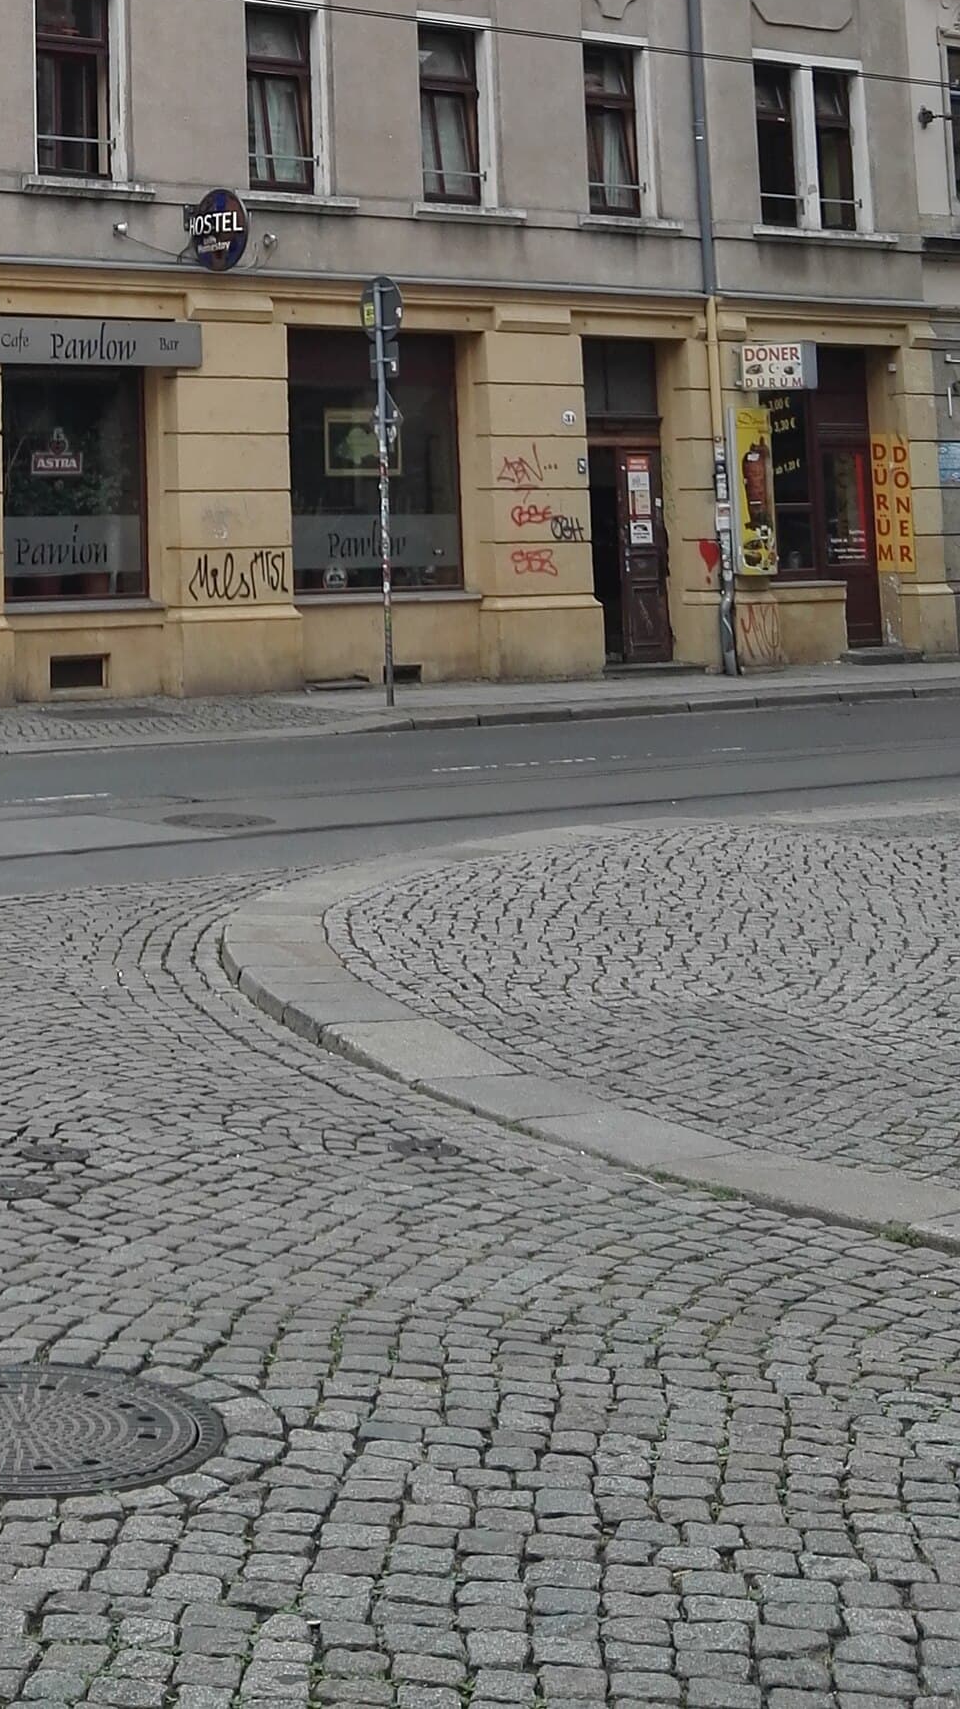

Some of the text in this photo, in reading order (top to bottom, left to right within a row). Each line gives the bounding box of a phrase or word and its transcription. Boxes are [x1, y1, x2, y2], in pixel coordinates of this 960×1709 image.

[189, 211, 243, 235] HOSTEL
[1, 322, 179, 360] Cafe Pawlow Bar
[36, 458, 77, 469] ASTRA
[872, 443, 893, 561] DÜRÜM
[892, 446, 912, 562] DÖNER
[328, 519, 406, 558] Pawlw
